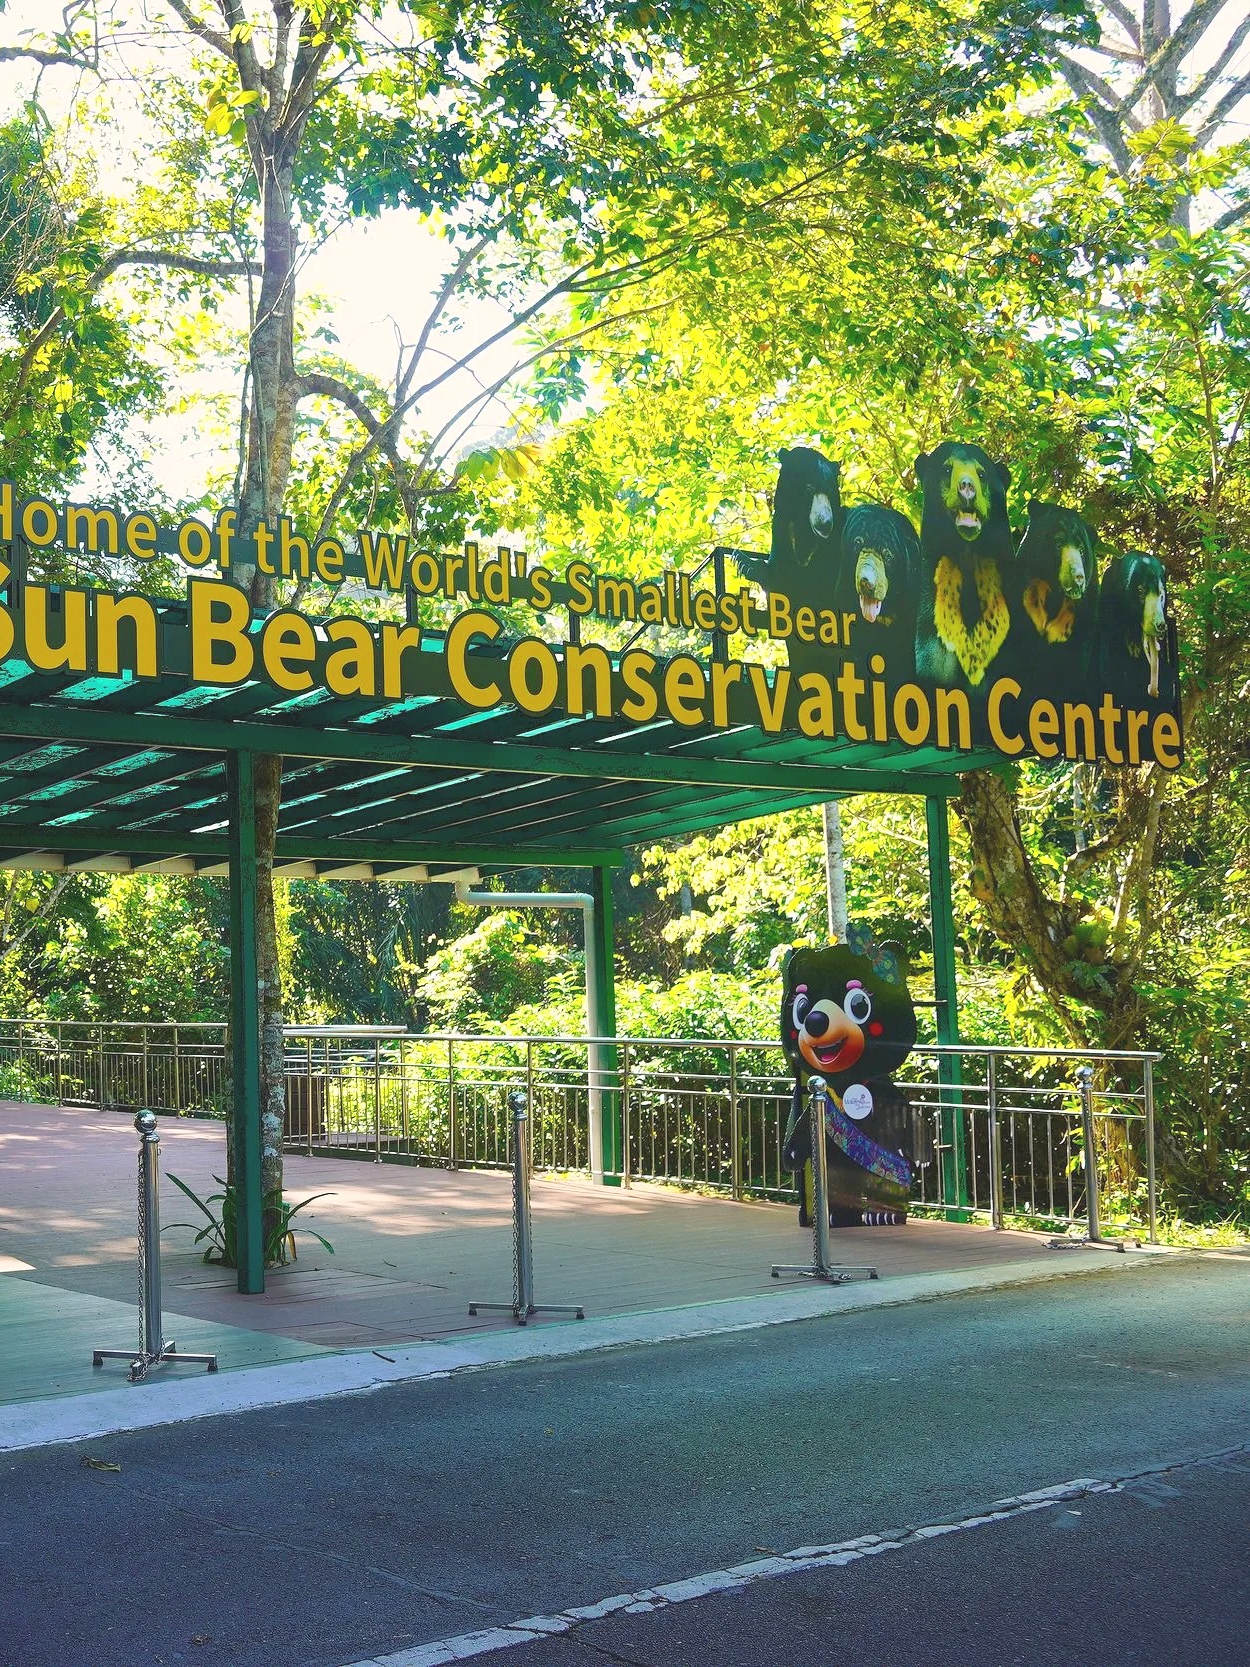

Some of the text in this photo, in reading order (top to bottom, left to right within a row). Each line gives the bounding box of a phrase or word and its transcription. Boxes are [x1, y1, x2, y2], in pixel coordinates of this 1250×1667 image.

[180, 510, 236, 568] of
[253, 518, 343, 582] the
[363, 533, 551, 609] World's
[569, 563, 755, 632] Smallest
[770, 593, 856, 645] Bear
[191, 581, 420, 699] Bear
[447, 612, 971, 749] Conservation
[987, 677, 1182, 769] Centre
